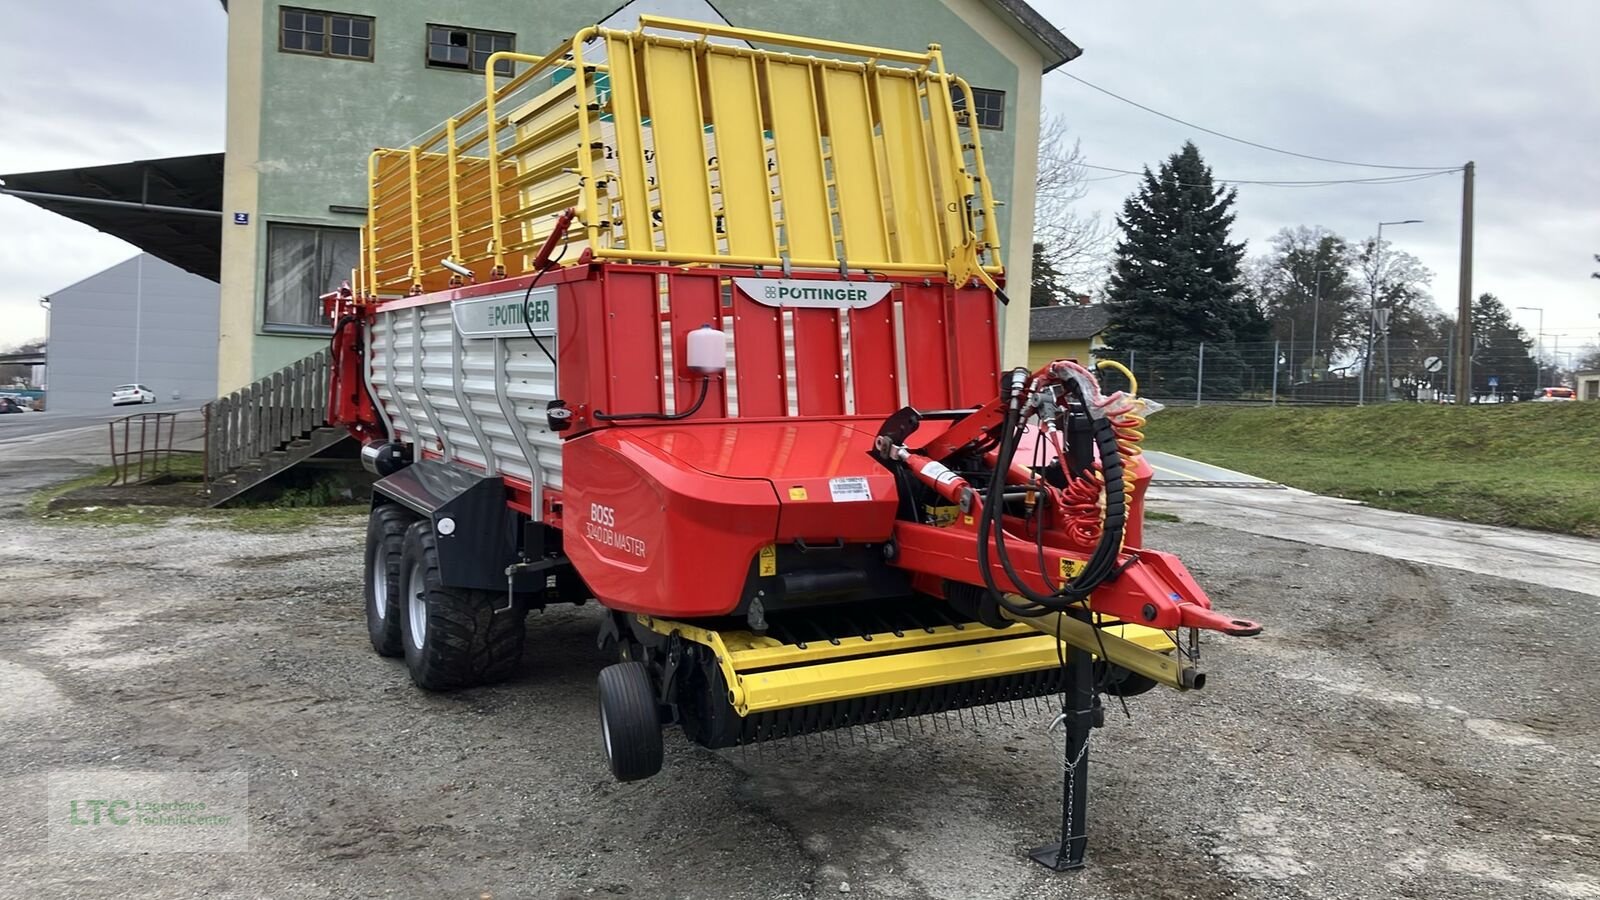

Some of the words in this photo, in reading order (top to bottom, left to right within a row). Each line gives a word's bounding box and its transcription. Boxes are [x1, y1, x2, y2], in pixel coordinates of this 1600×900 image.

[591, 503, 614, 527] BOSS
[603, 528, 613, 546] DB
[614, 532, 646, 558] MASTER
